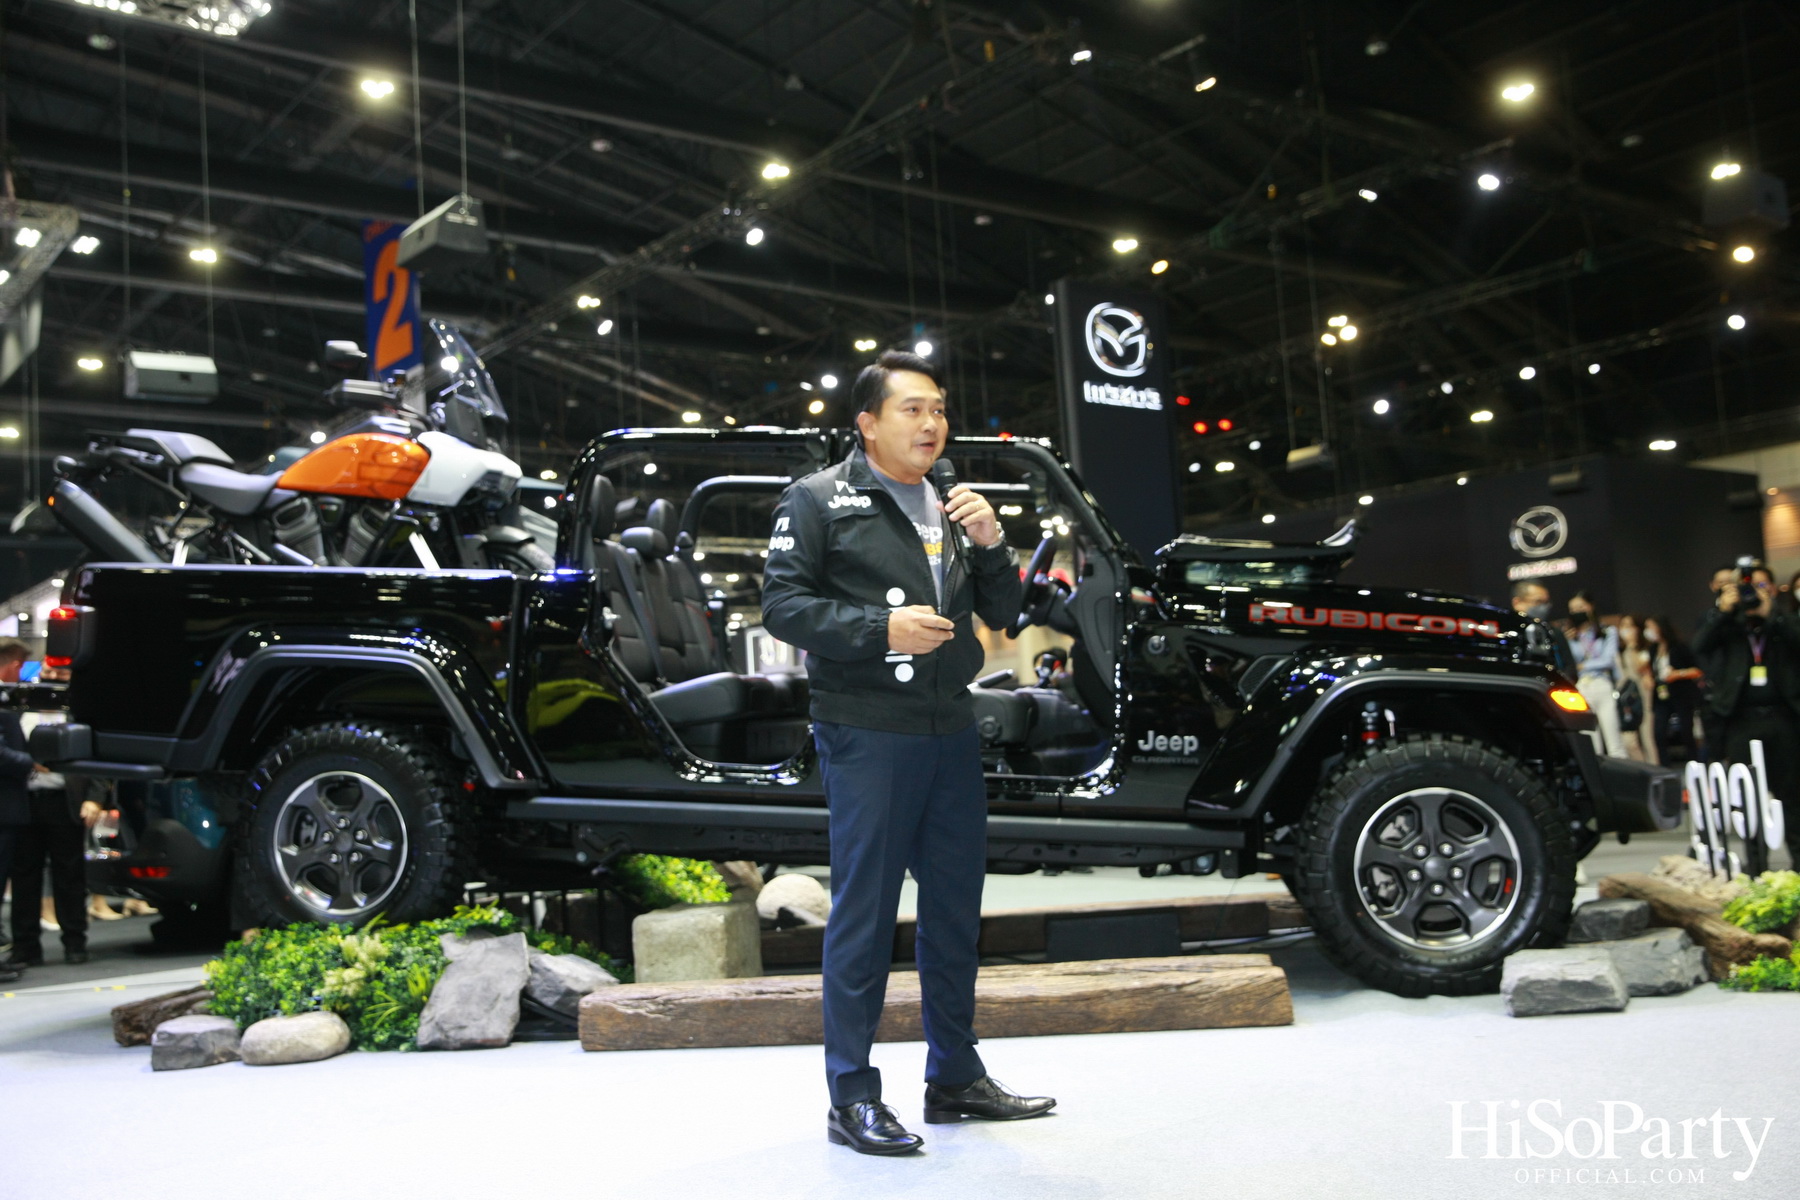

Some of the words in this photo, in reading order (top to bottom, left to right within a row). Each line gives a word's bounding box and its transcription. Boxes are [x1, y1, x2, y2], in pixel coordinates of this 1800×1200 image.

[373, 239, 413, 371] 2
[827, 494, 872, 509] Jeep
[769, 535, 795, 551] eep
[911, 521, 943, 544] eep
[1248, 603, 1500, 638] RUBICON
[1137, 730, 1199, 755] Jeep
